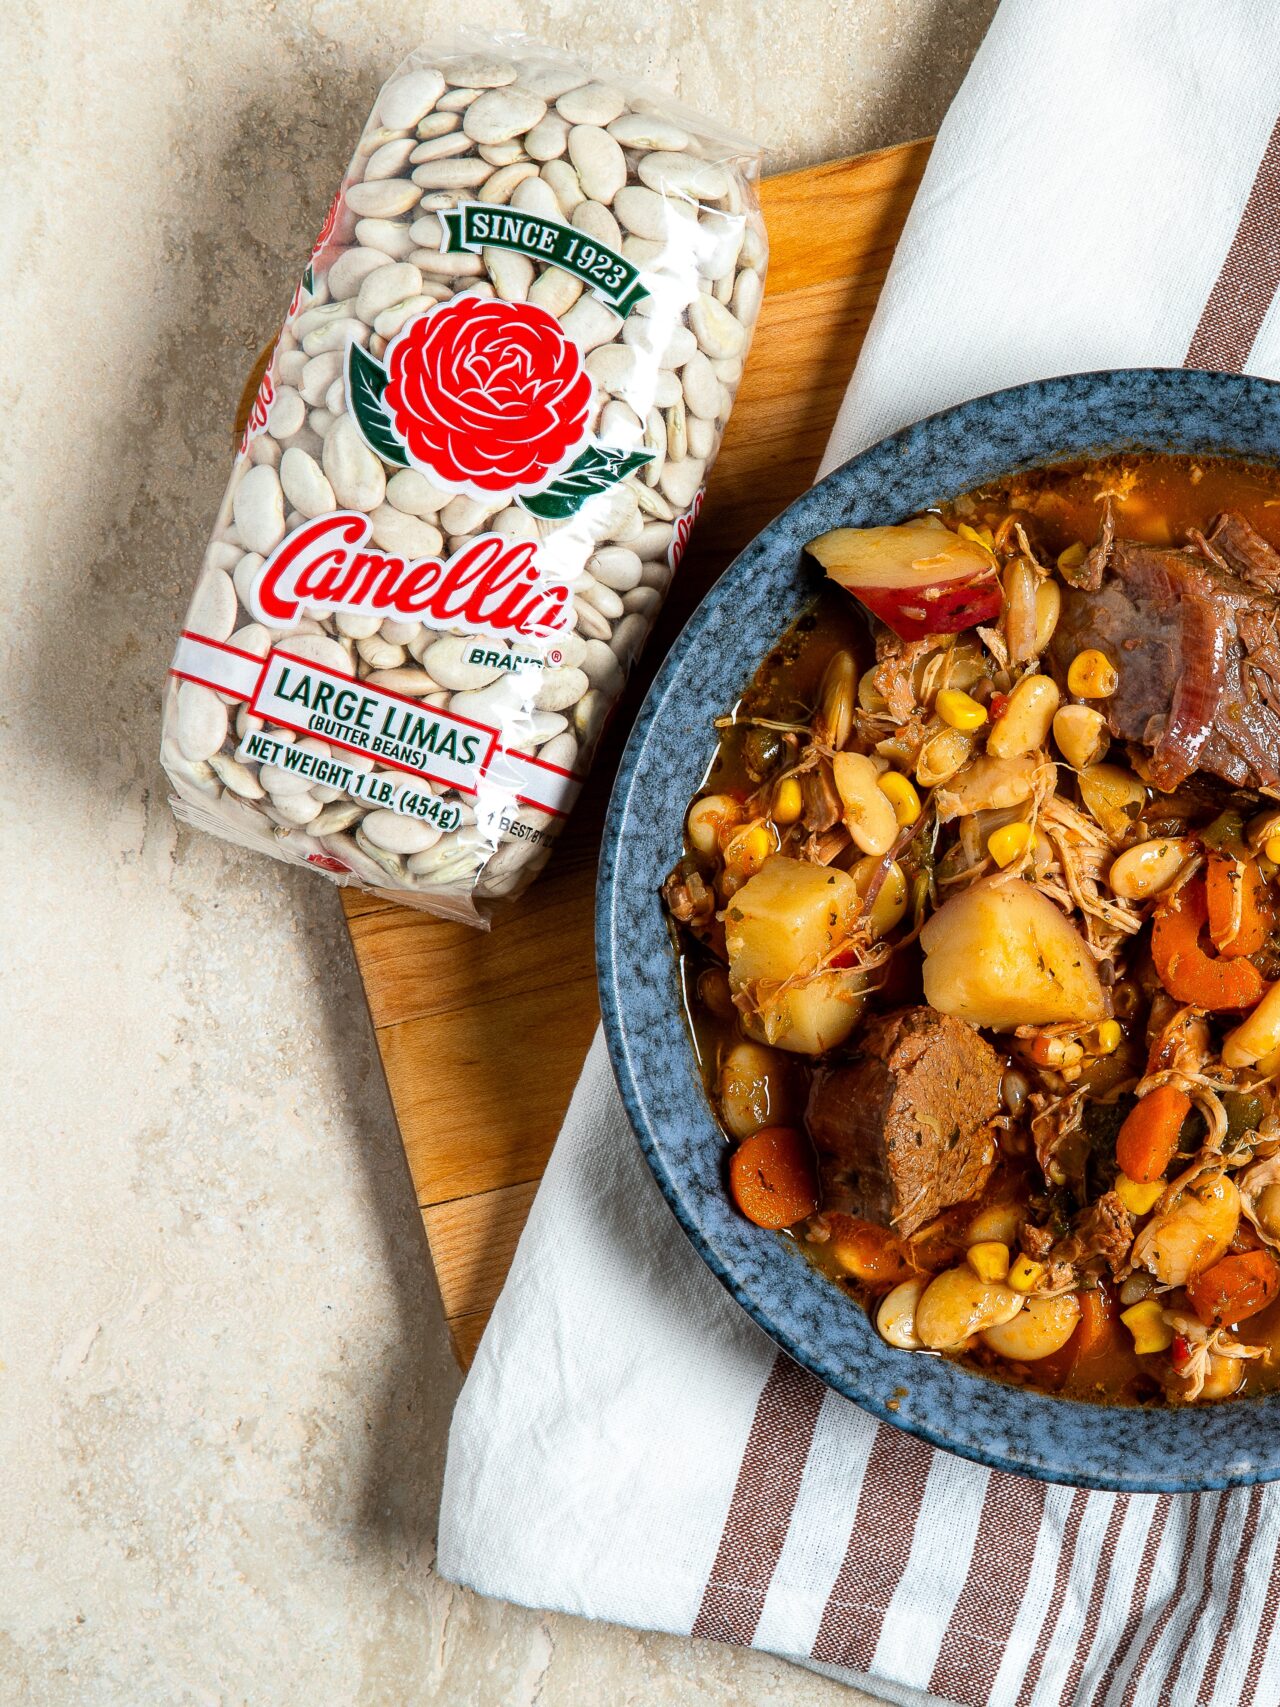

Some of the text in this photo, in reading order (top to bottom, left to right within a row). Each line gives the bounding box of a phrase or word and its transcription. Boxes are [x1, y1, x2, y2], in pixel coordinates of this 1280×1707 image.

[473, 213, 628, 288] SINCE 1923
[259, 515, 569, 638] Camellia
[274, 667, 481, 765] LARGE LIMAS
[308, 714, 427, 769] (BUTTER BEANS)
[246, 735, 460, 829] NET WEIGHT 1 LB. (454g)
[498, 817, 533, 840] BEST
